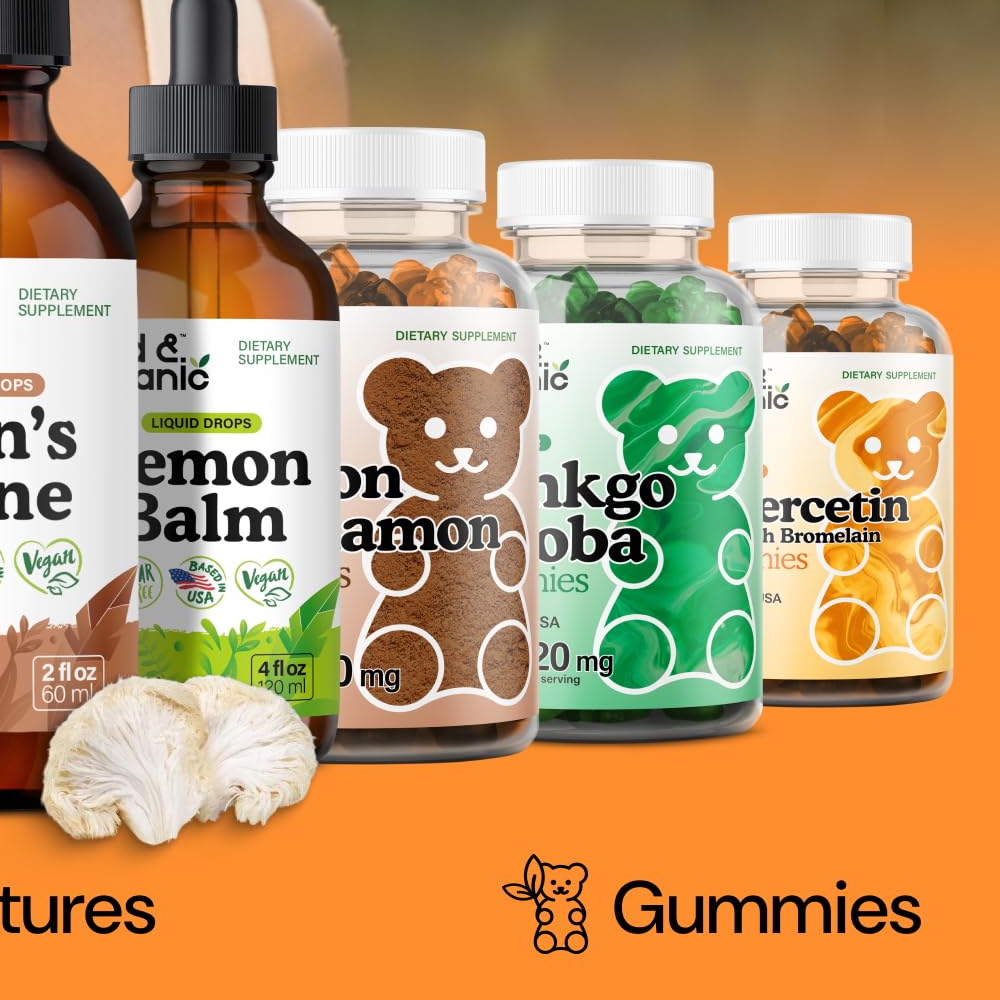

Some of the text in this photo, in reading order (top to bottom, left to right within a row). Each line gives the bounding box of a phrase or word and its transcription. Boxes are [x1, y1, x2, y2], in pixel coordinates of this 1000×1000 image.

[19, 289, 77, 300] DIETARY
[18, 304, 111, 317] SUPPLEMENT
[396, 331, 517, 342] DIETARY SUPPLEMENT
[239, 341, 291, 351] DIETARY
[632, 345, 742, 356] DIETARY SUPPLEMENT
[239, 354, 319, 366] SUPPLEMENT
[842, 371, 936, 380] DIETARY SUPPLEMENT
[152, 418, 251, 430] LIQUID DROPS
[138, 493, 287, 542] Balm
[780, 528, 881, 543] Bromelain
[22, 549, 76, 576] Vegan
[189, 560, 225, 593] BASED IN
[242, 568, 288, 592] Vegan
[187, 591, 214, 604] USA
[763, 593, 781, 604] SA
[259, 660, 306, 675] 4 fl oz
[577, 653, 613, 676] mg
[43, 663, 96, 681] 2 fl oz
[288, 679, 306, 694] ml
[360, 667, 400, 692] mg
[541, 674, 580, 686] serving
[42, 684, 94, 703] 60 ml
